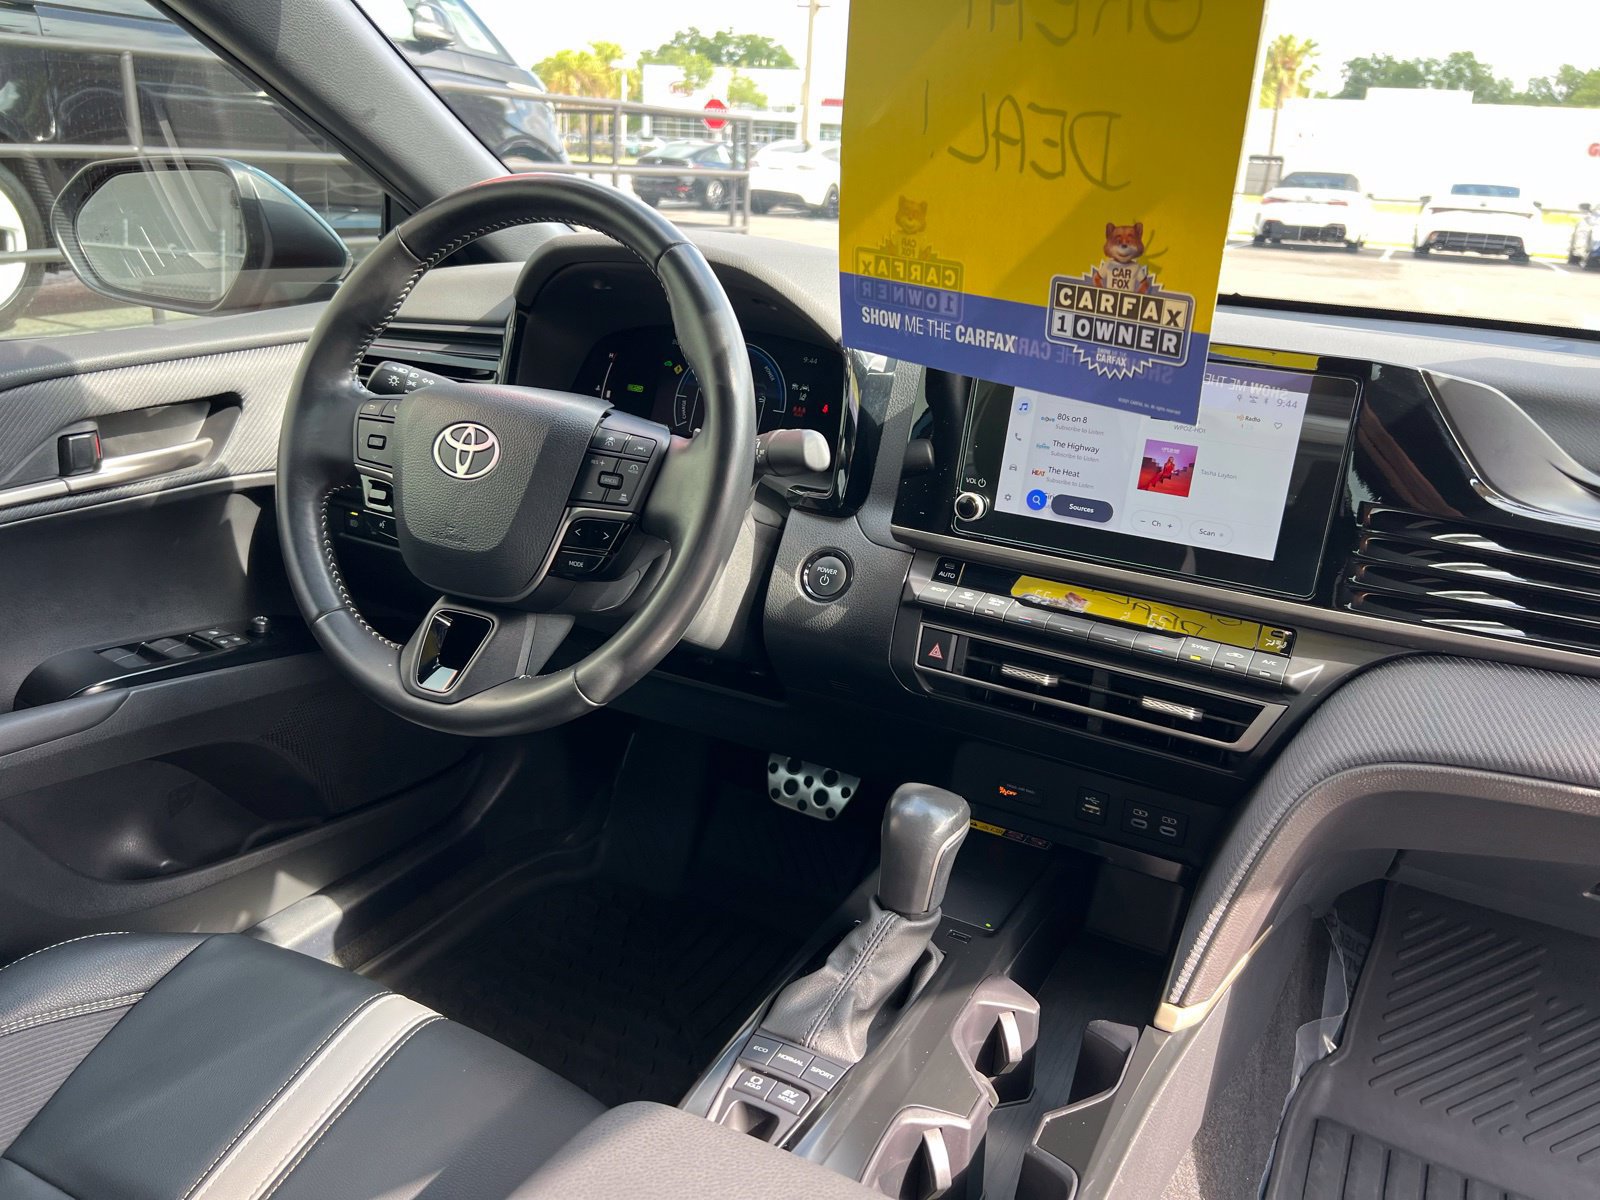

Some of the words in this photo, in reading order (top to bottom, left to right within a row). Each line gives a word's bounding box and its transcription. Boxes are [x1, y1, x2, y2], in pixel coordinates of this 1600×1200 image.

[1111, 267, 1132, 279] CAR
[1111, 278, 1130, 290] FOX
[1058, 286, 1183, 328] CARFAX
[861, 305, 901, 330] SHOW
[904, 314, 924, 335] ME
[927, 318, 952, 341] THE
[955, 324, 1017, 354] CARFAX
[1096, 353, 1128, 367] CARFAX
[763, 365, 776, 382] POWER
[1276, 398, 1298, 409] 9:44
[1056, 412, 1070, 422] 80s
[1082, 416, 1088, 424] 8
[1052, 439, 1066, 449] The
[1066, 441, 1100, 455] Highway
[1031, 469, 1046, 477] HEAT
[1048, 466, 1061, 475] The
[1062, 469, 1080, 478] Heat
[965, 476, 977, 485] VOL
[1068, 502, 1095, 514] Sources
[1151, 519, 1162, 528] Ch
[1199, 527, 1216, 538] Scan
[568, 559, 585, 569] MODE
[816, 566, 838, 576] POWER
[938, 570, 956, 579] AUTO
[1191, 643, 1212, 652] SYNC
[1261, 659, 1278, 667] A/C
[752, 1045, 769, 1054] ECO
[777, 1052, 804, 1068] NORMAL
[810, 1066, 835, 1081] SPORT
[744, 1081, 762, 1091] HOLD
